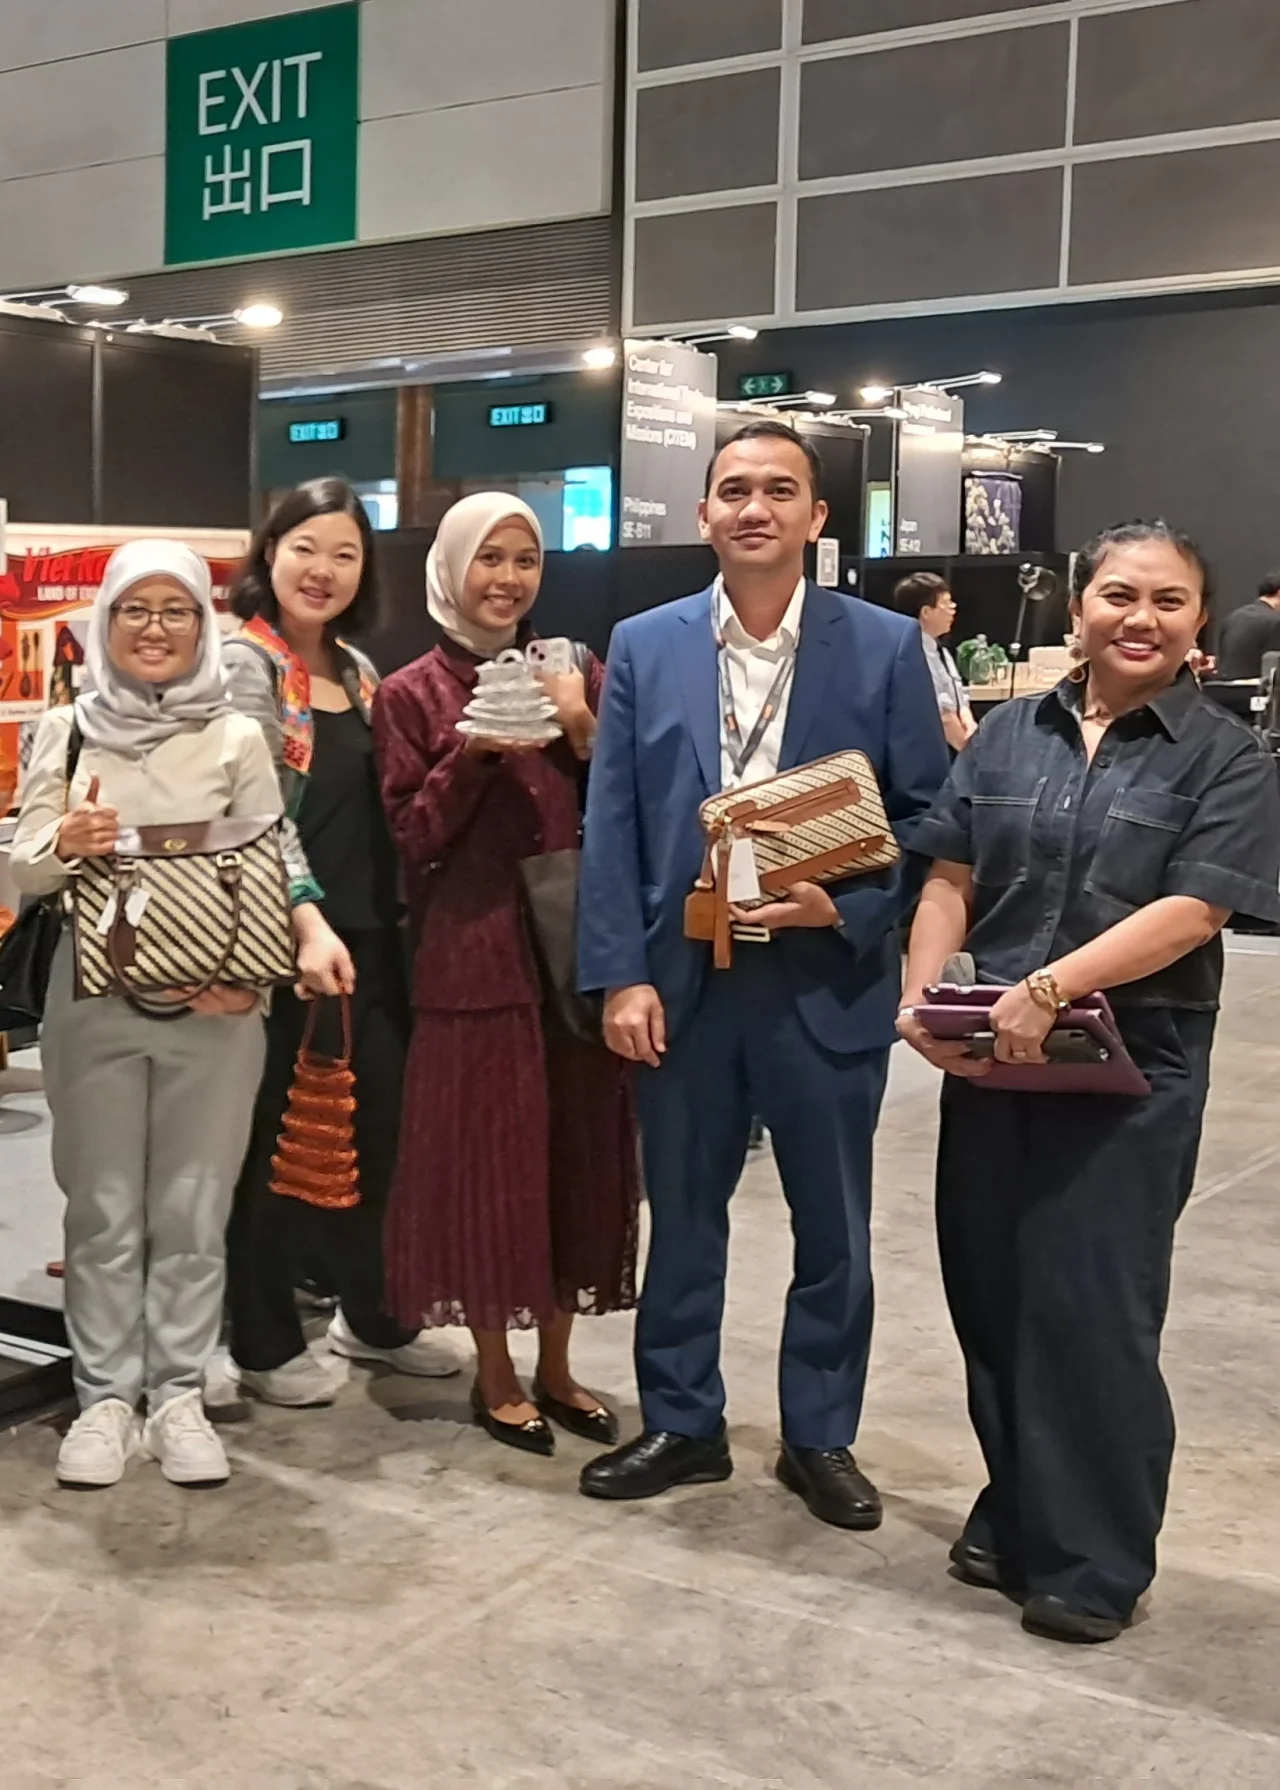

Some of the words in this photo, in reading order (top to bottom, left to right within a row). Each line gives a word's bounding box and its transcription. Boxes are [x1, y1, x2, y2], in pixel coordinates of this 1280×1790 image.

[198, 50, 323, 136] EXIT
[202, 137, 312, 221] 出口
[491, 406, 520, 426] EXIT
